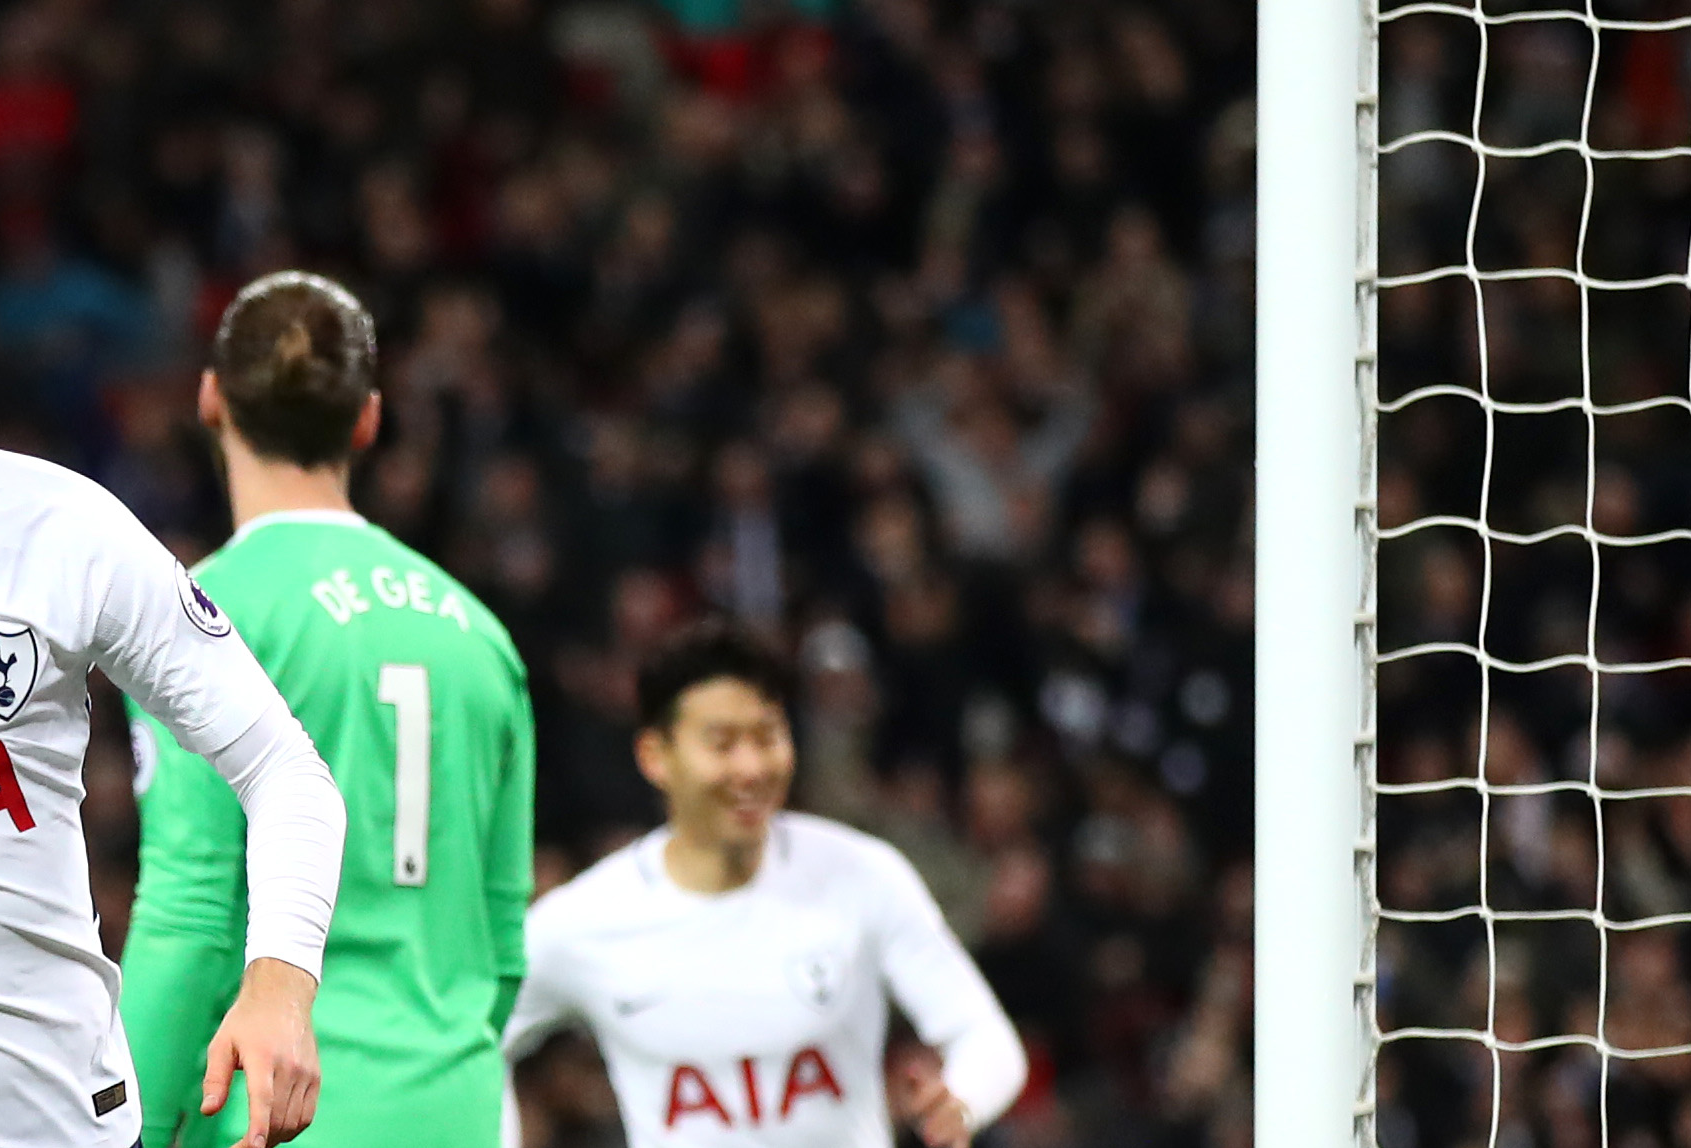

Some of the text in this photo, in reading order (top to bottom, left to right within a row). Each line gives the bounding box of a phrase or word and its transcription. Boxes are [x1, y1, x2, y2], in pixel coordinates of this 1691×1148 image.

[311, 565, 471, 633] DE GEA
[377, 662, 432, 887] 1
[664, 1044, 844, 1132] AIA
